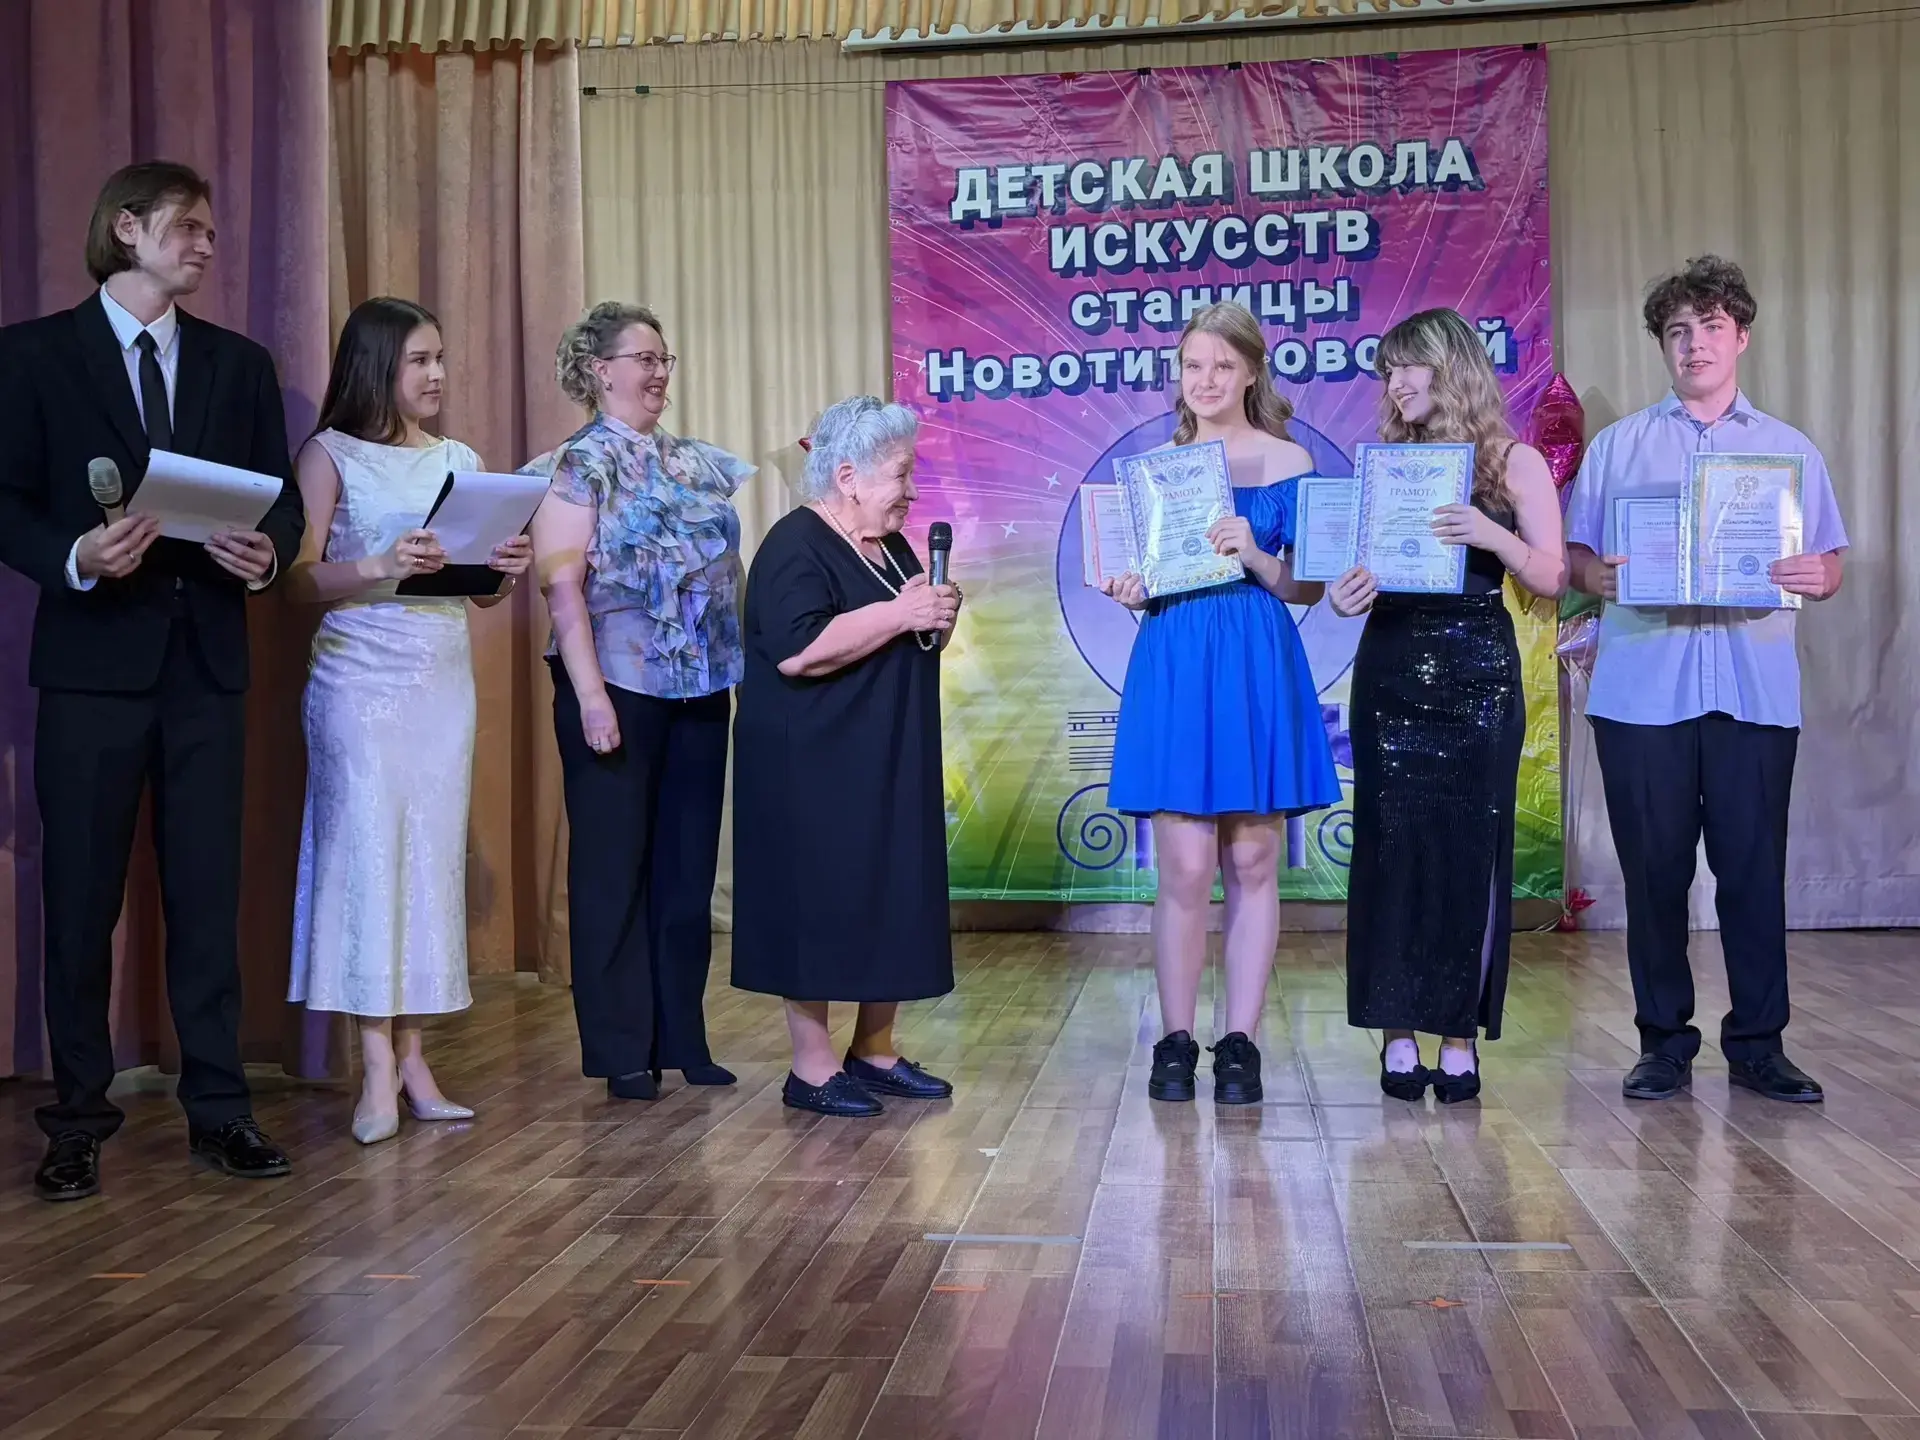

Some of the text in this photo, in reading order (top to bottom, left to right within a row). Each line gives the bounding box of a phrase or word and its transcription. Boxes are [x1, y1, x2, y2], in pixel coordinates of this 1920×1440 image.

[950, 139, 1474, 221] ДЕТСКАЯ ШКОЛА
[1050, 210, 1371, 270] ИСКУССТВ
[1070, 278, 1350, 328] станицы
[1389, 487, 1438, 497] ГРАМОТА
